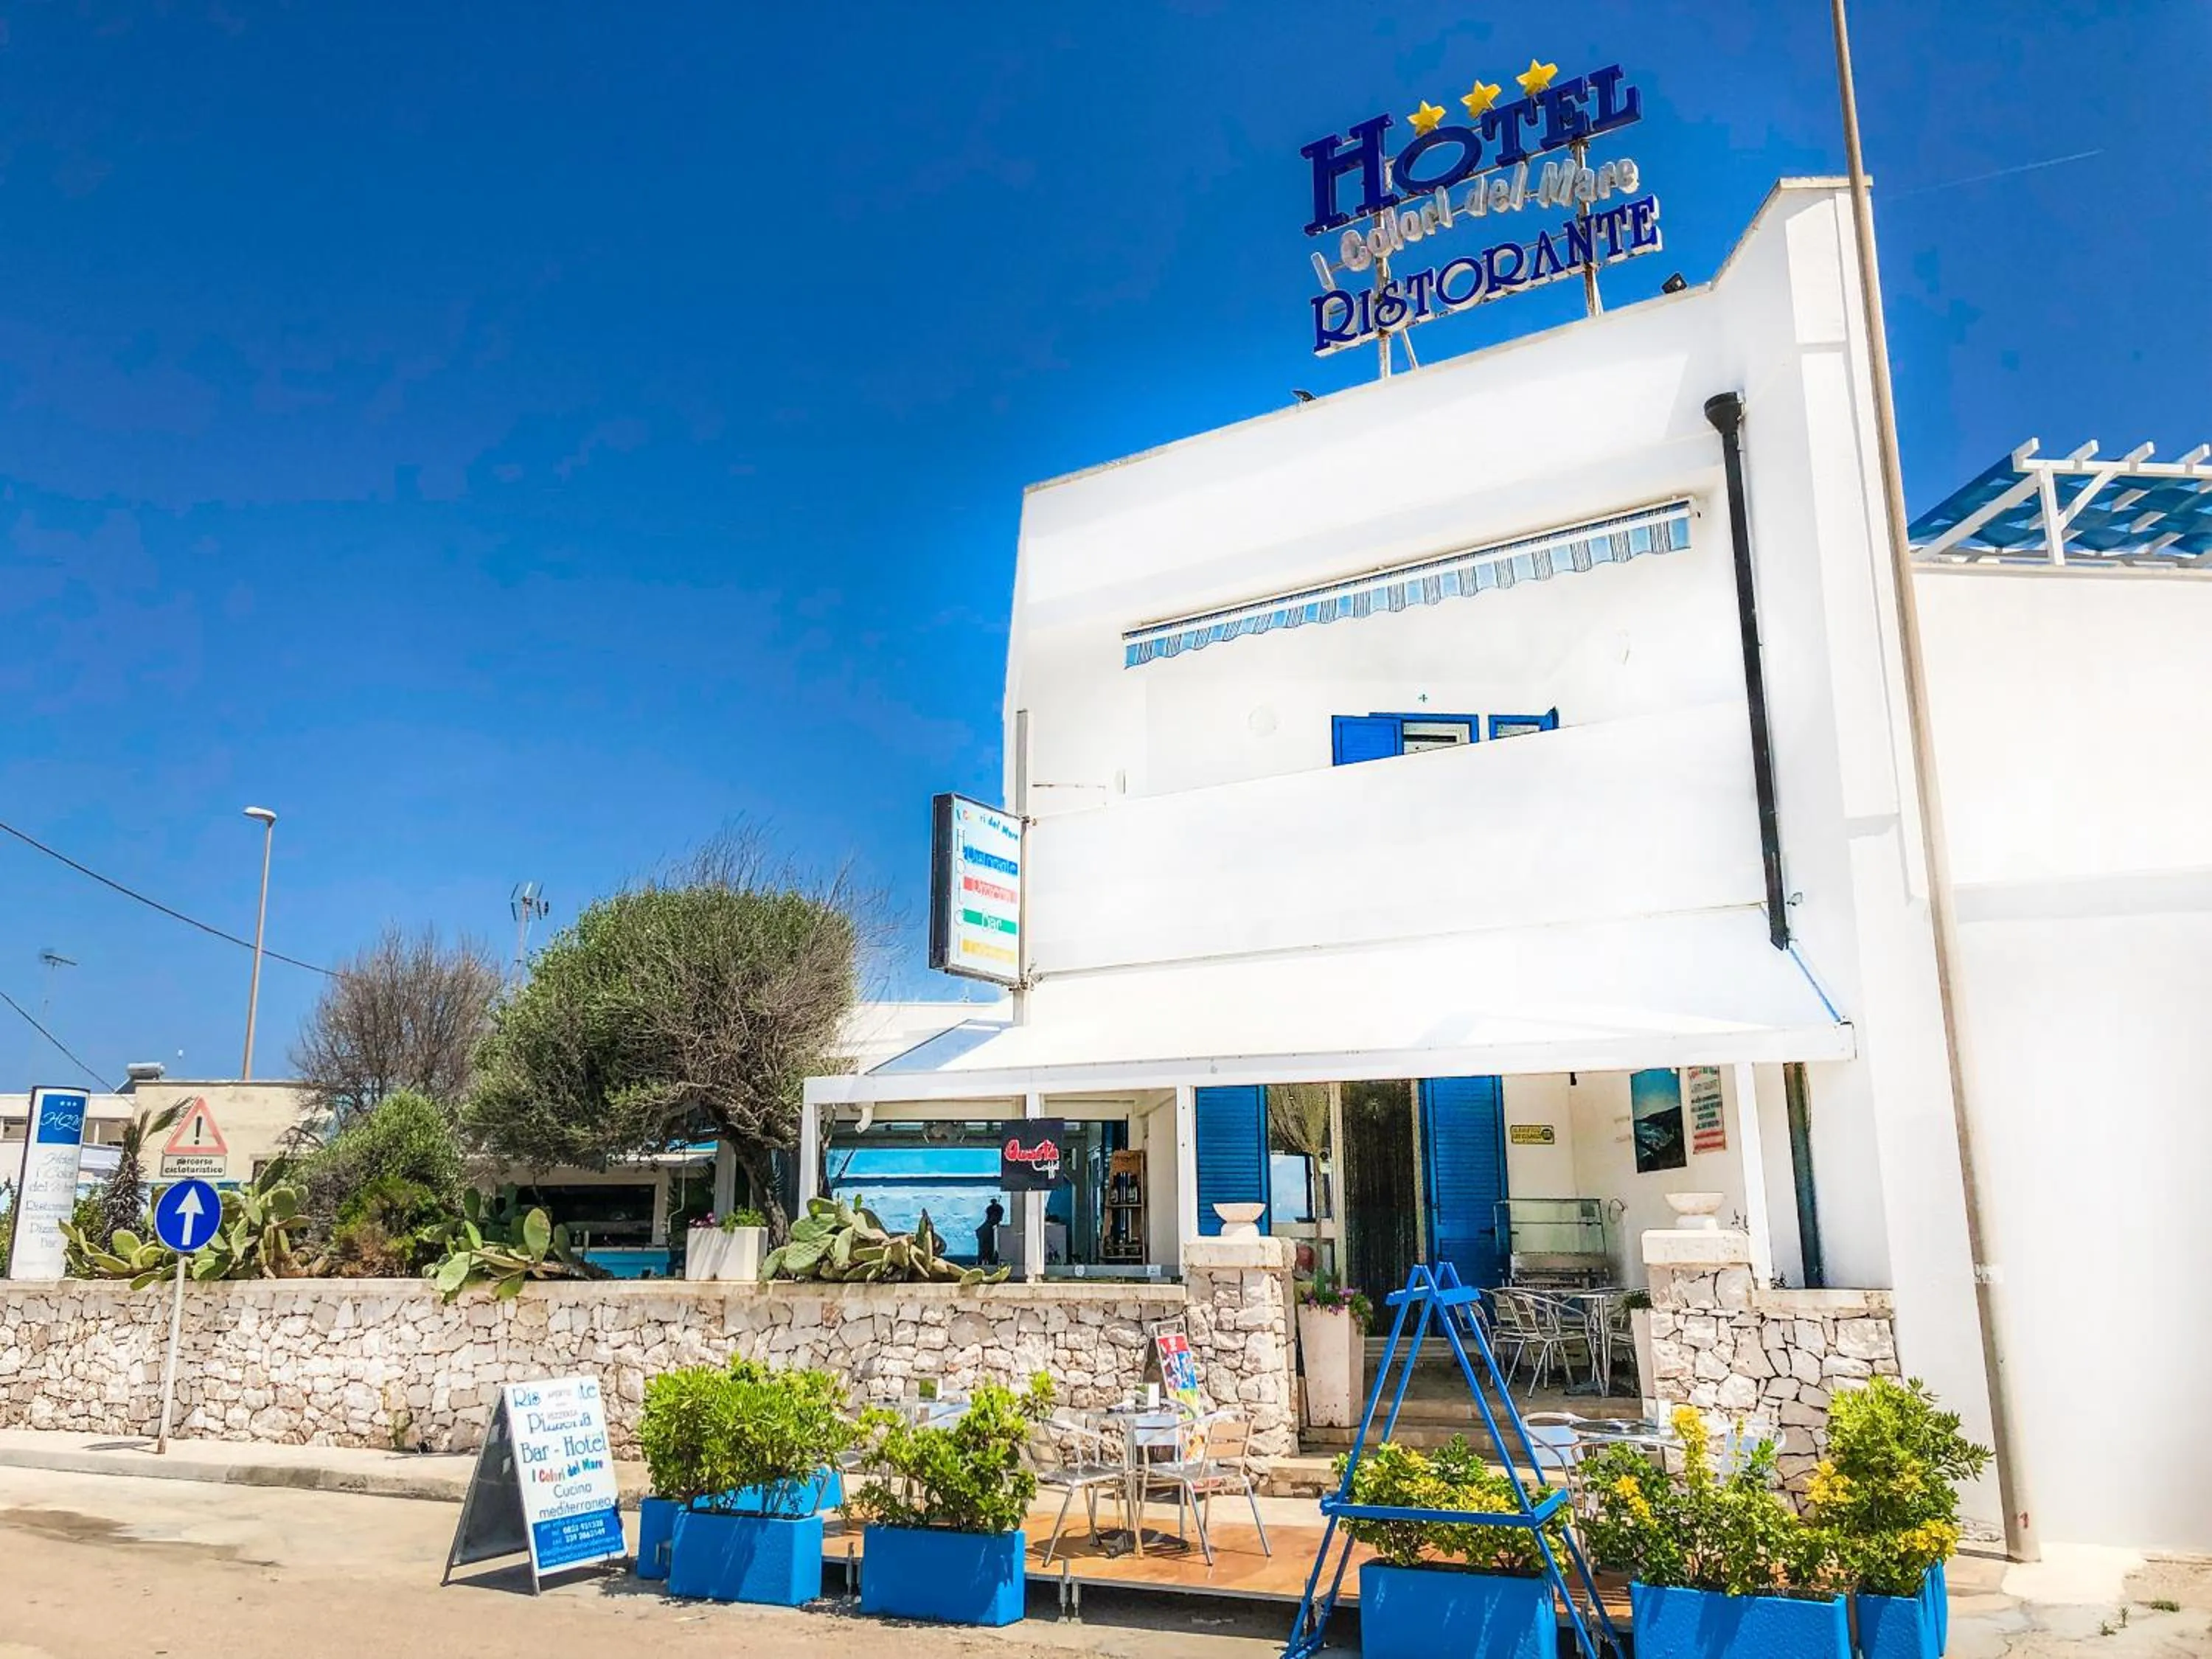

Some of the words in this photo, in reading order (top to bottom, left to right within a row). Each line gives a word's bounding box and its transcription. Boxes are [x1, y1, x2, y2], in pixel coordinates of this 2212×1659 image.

[1301, 64, 1641, 236] HOTEL
[1340, 186, 1453, 271] Colori
[1464, 162, 1528, 216] del
[1538, 159, 1639, 209] Mare
[1310, 195, 1663, 357] RISTORANTE
[177, 1157, 212, 1165] percorso
[520, 1442, 549, 1464] Bar
[563, 1430, 607, 1457] Hotel
[539, 1467, 566, 1483] Colori
[567, 1459, 580, 1477] del
[582, 1458, 604, 1471] Mare
[554, 1483, 592, 1498] Cucina
